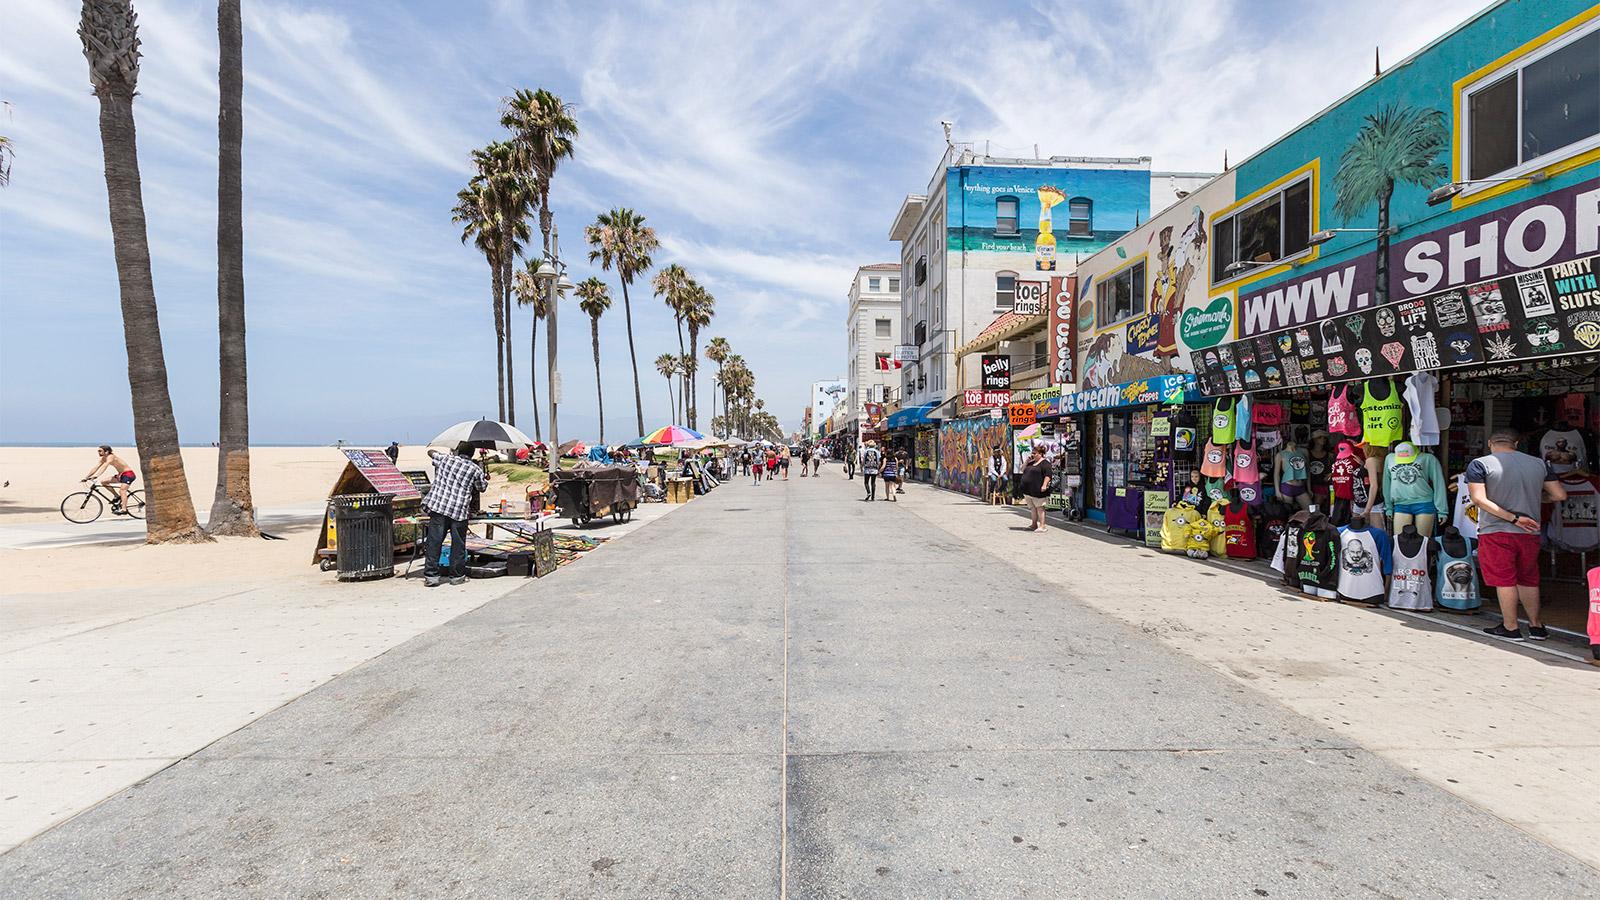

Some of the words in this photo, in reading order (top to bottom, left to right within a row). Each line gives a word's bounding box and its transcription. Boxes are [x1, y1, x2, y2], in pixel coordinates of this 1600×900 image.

[963, 183, 990, 194] Anything
[1552, 258, 1592, 280] PARTY
[1517, 270, 1544, 283] MISSING
[1555, 274, 1597, 295] WITH
[1016, 284, 1040, 301] toe
[1015, 300, 1040, 314] rings
[1559, 290, 1600, 310] SLUTS
[1401, 311, 1427, 326] LIFT
[1478, 321, 1510, 334] BLUNT
[983, 359, 1009, 375] belly
[1301, 359, 1320, 370] DOPE
[1414, 356, 1441, 370] DATES
[986, 375, 1009, 387] rings
[965, 391, 982, 404] toe
[984, 390, 1010, 406] rings
[1076, 385, 1120, 412] cream
[1011, 406, 1034, 416] toe
[1012, 415, 1034, 423] rings
